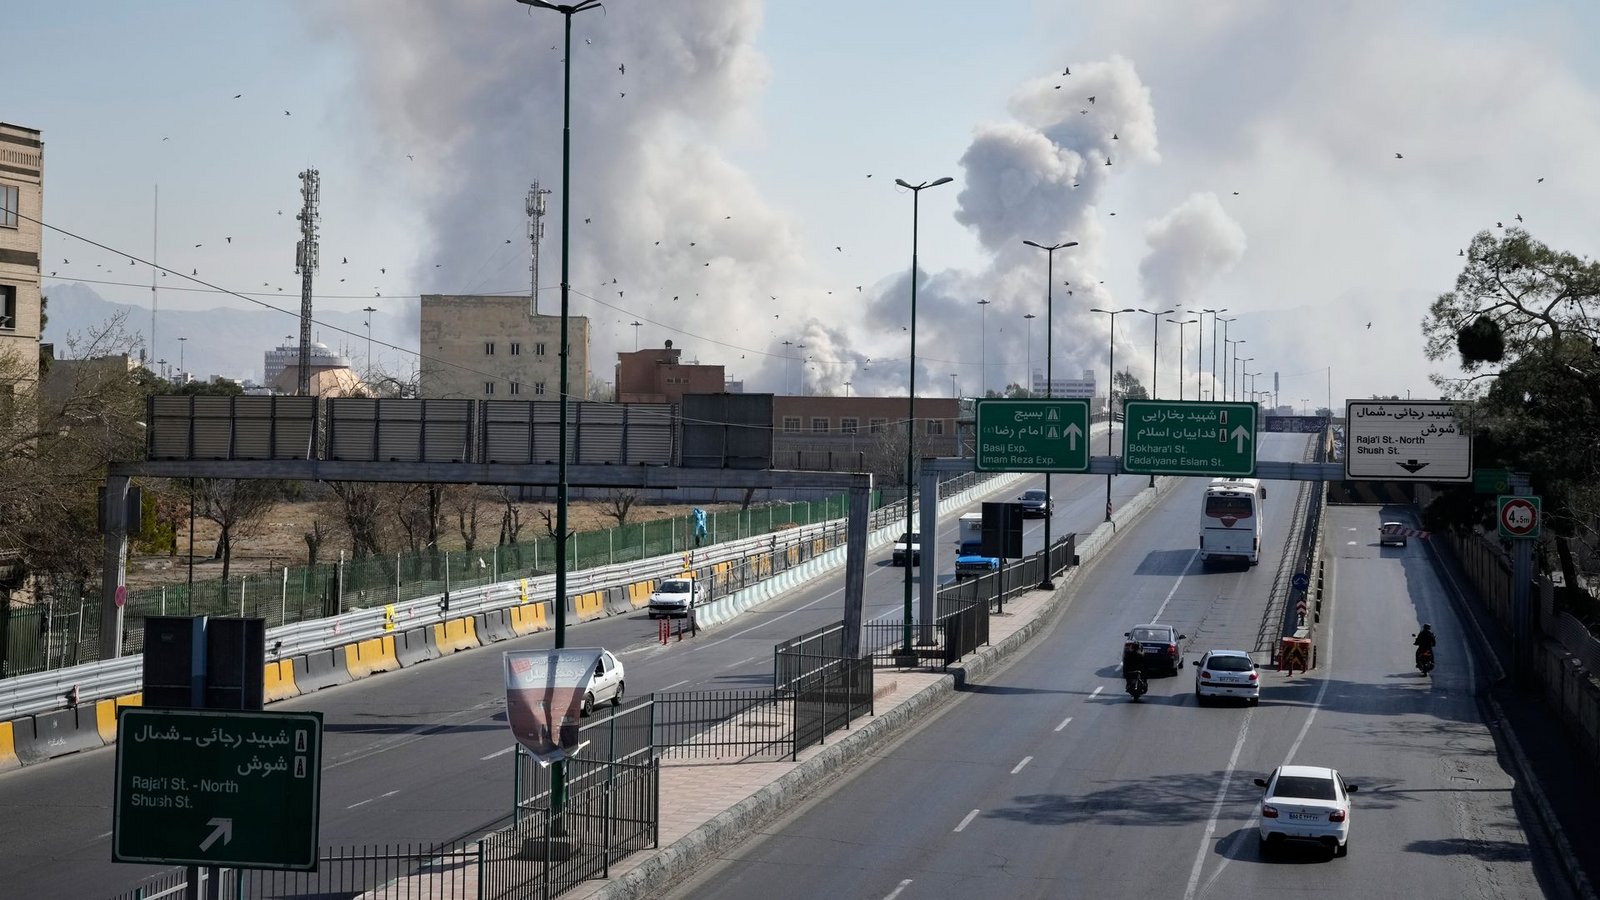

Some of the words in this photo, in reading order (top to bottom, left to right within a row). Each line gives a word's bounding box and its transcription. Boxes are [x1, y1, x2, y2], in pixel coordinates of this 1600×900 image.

[1014, 410, 1043, 422] بسیج
[1186, 410, 1217, 423] شهید
[1356, 406, 1386, 418] شمال
[1428, 407, 1456, 420] شهید
[1018, 425, 1043, 439] امام
[1137, 427, 1169, 440] اسلام
[1421, 424, 1455, 437] شوش
[1356, 435, 1380, 445] Raja'i
[983, 444, 1005, 454] Basij
[1008, 444, 1027, 453] Exp.
[1174, 445, 1187, 454] St.
[1357, 446, 1384, 455] Shush
[1387, 447, 1400, 455] St.
[983, 456, 1008, 464] Imam
[1010, 456, 1034, 464] Reza
[1036, 456, 1056, 465] Exp.
[1180, 457, 1208, 466] Eslam
[1211, 458, 1224, 467] St.
[134, 724, 180, 742] شمال
[245, 729, 290, 748] شهید
[237, 755, 288, 778] شوش
[132, 776, 167, 792] Raja'i
[171, 778, 189, 791] St.
[200, 779, 239, 793] North
[131, 793, 172, 808] Shush
[175, 795, 193, 809] St.
